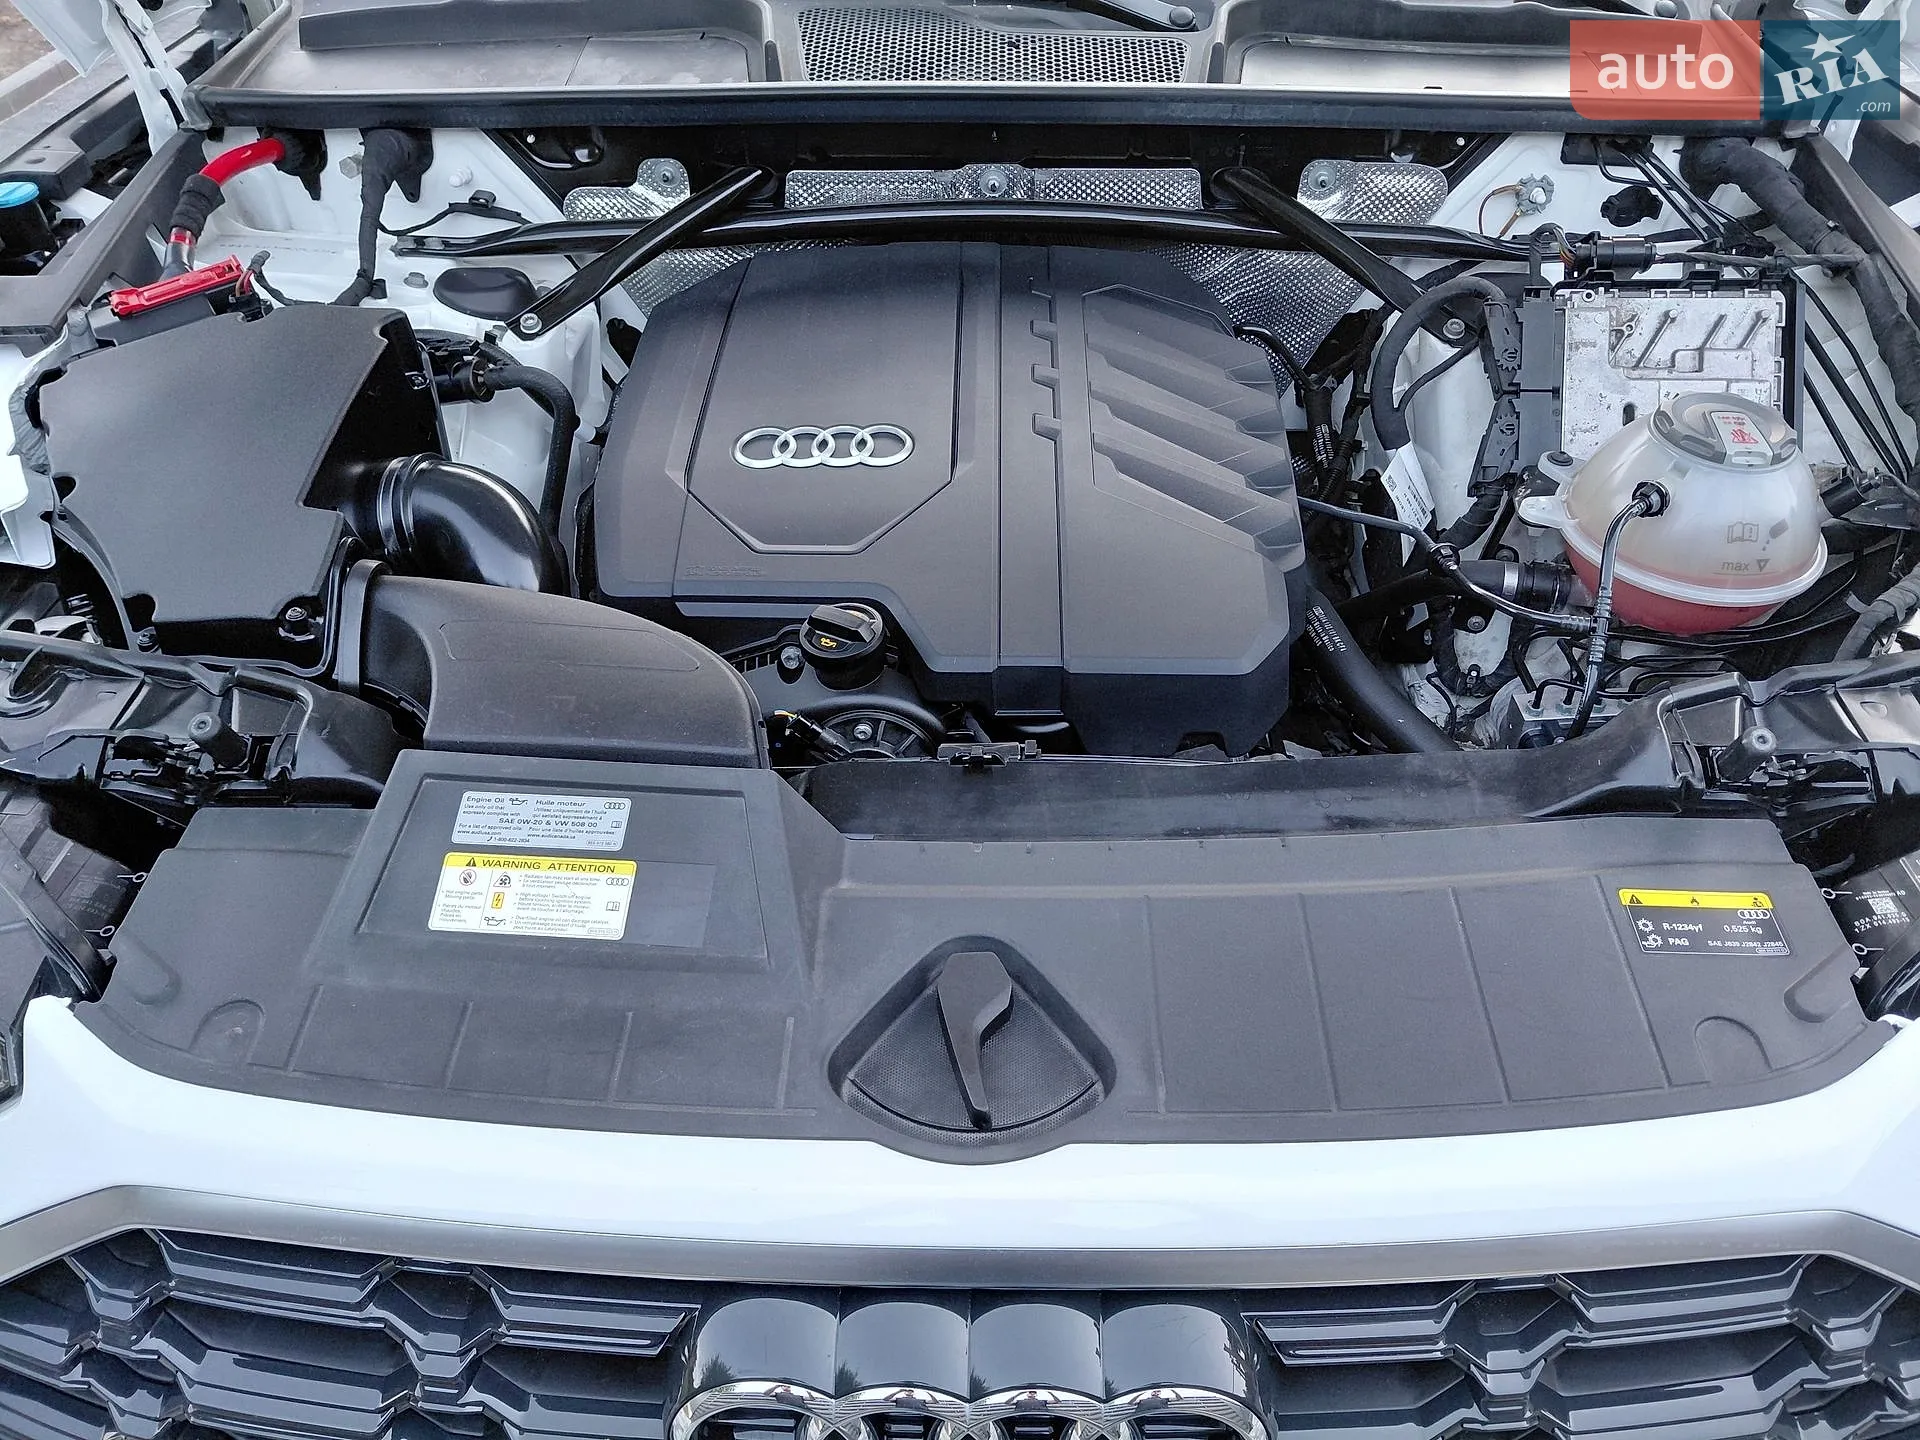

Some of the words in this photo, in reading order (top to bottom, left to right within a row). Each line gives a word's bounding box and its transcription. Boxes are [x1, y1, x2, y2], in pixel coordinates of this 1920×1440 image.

[1722, 561, 1749, 571] max
[482, 859, 541, 869] WARNING
[547, 862, 616, 873] ATTENTION
[1662, 923, 1703, 932] R-1234yf
[1750, 925, 1763, 934] kg
[1668, 937, 1689, 946] PAG
